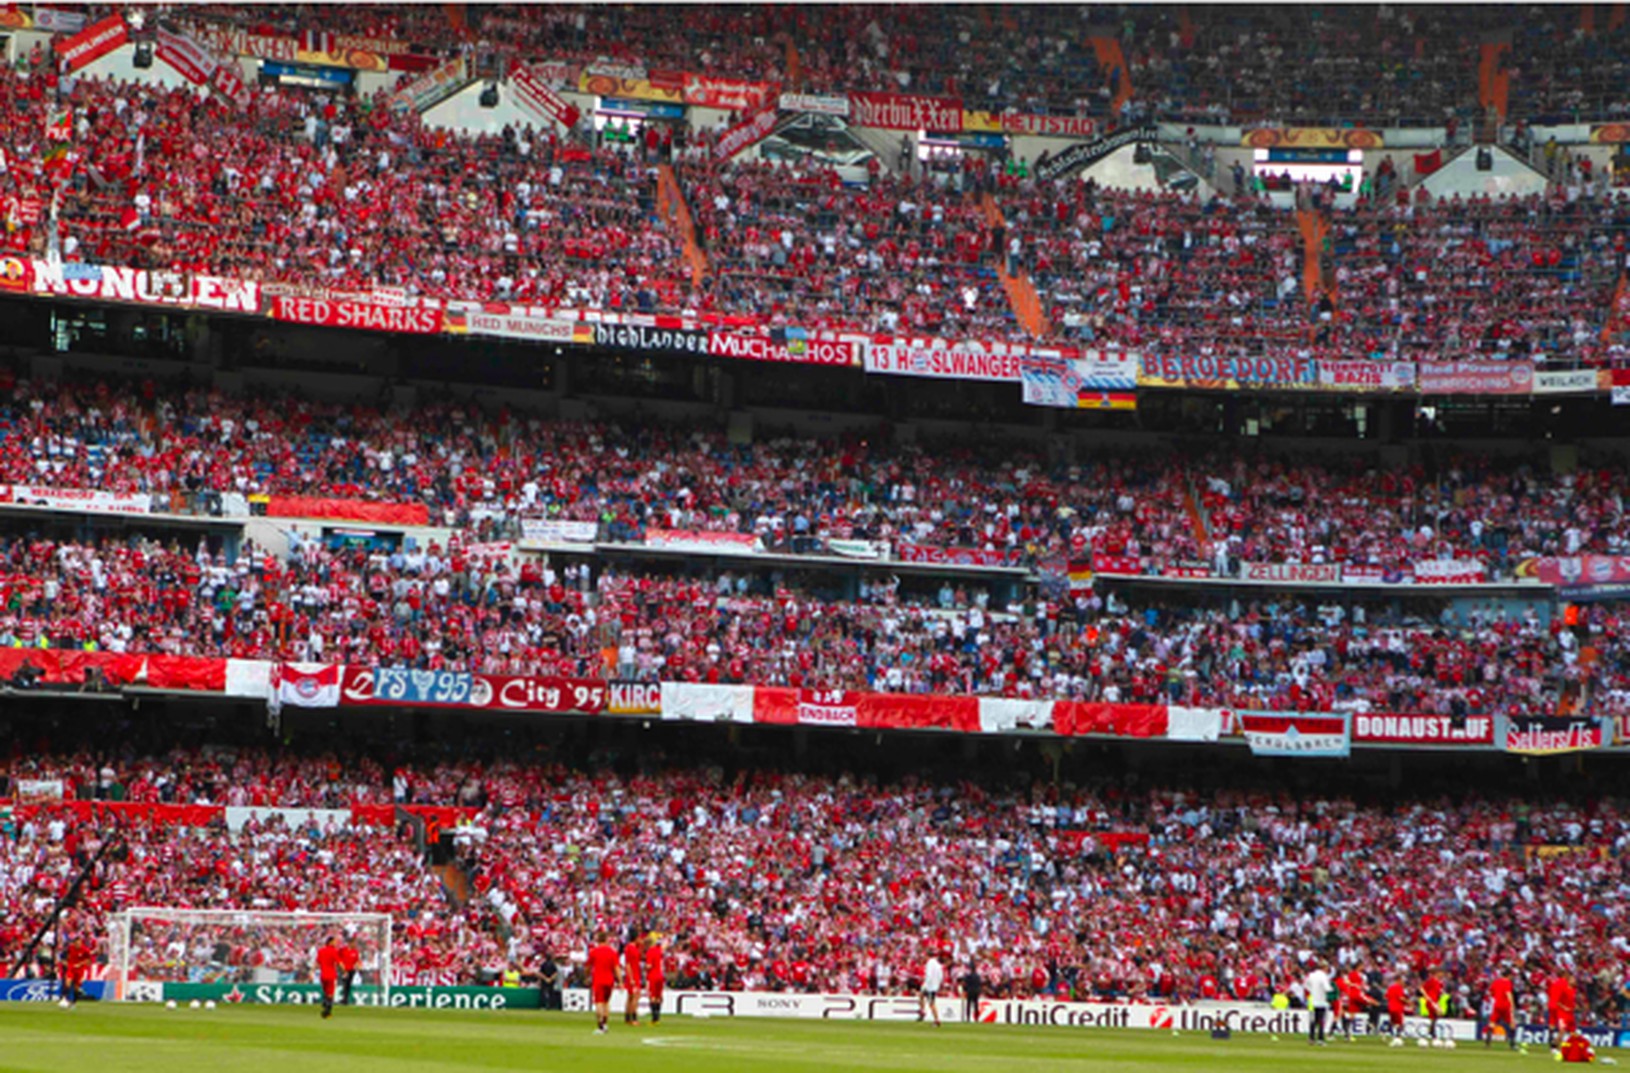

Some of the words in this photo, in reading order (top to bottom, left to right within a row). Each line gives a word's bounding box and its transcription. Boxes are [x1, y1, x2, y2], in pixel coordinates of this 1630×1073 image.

[279, 297, 330, 324] RED
[336, 303, 436, 332] SHARKS
[471, 315, 501, 330] RED
[710, 333, 848, 363] MUCHAHOS
[871, 347, 890, 370] 13
[896, 350, 1021, 378] HSLWANGER
[1142, 353, 1309, 382] BERGEDORF
[1248, 563, 1336, 582] ZELLINGEN
[435, 671, 468, 702] 95
[500, 679, 561, 708] City
[611, 684, 660, 708] KIRC
[255, 985, 321, 1004] Star
[757, 999, 802, 1009] SONY
[1005, 1002, 1129, 1028] UniCredit
